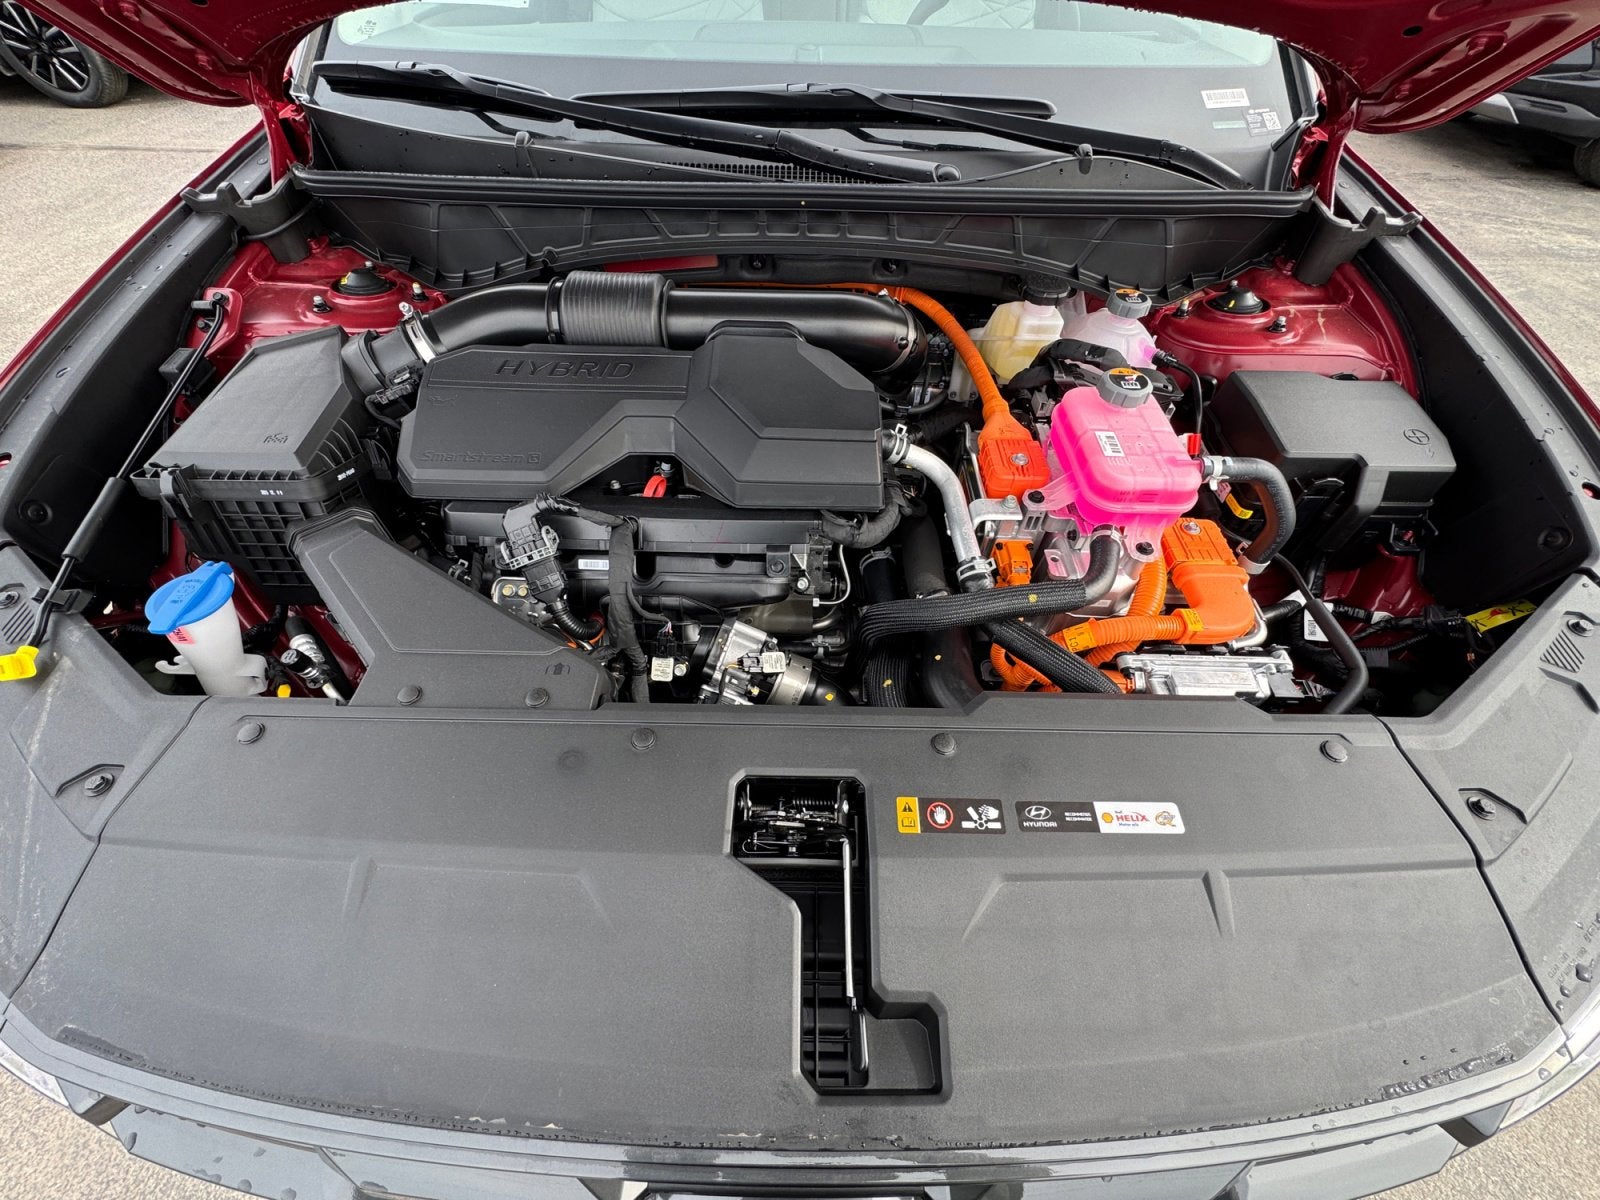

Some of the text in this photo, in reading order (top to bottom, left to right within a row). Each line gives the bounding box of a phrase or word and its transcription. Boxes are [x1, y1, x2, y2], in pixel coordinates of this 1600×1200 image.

[496, 359, 635, 379] HYBRID
[421, 449, 525, 463] Smartstream
[1115, 814, 1149, 822] HELIX
